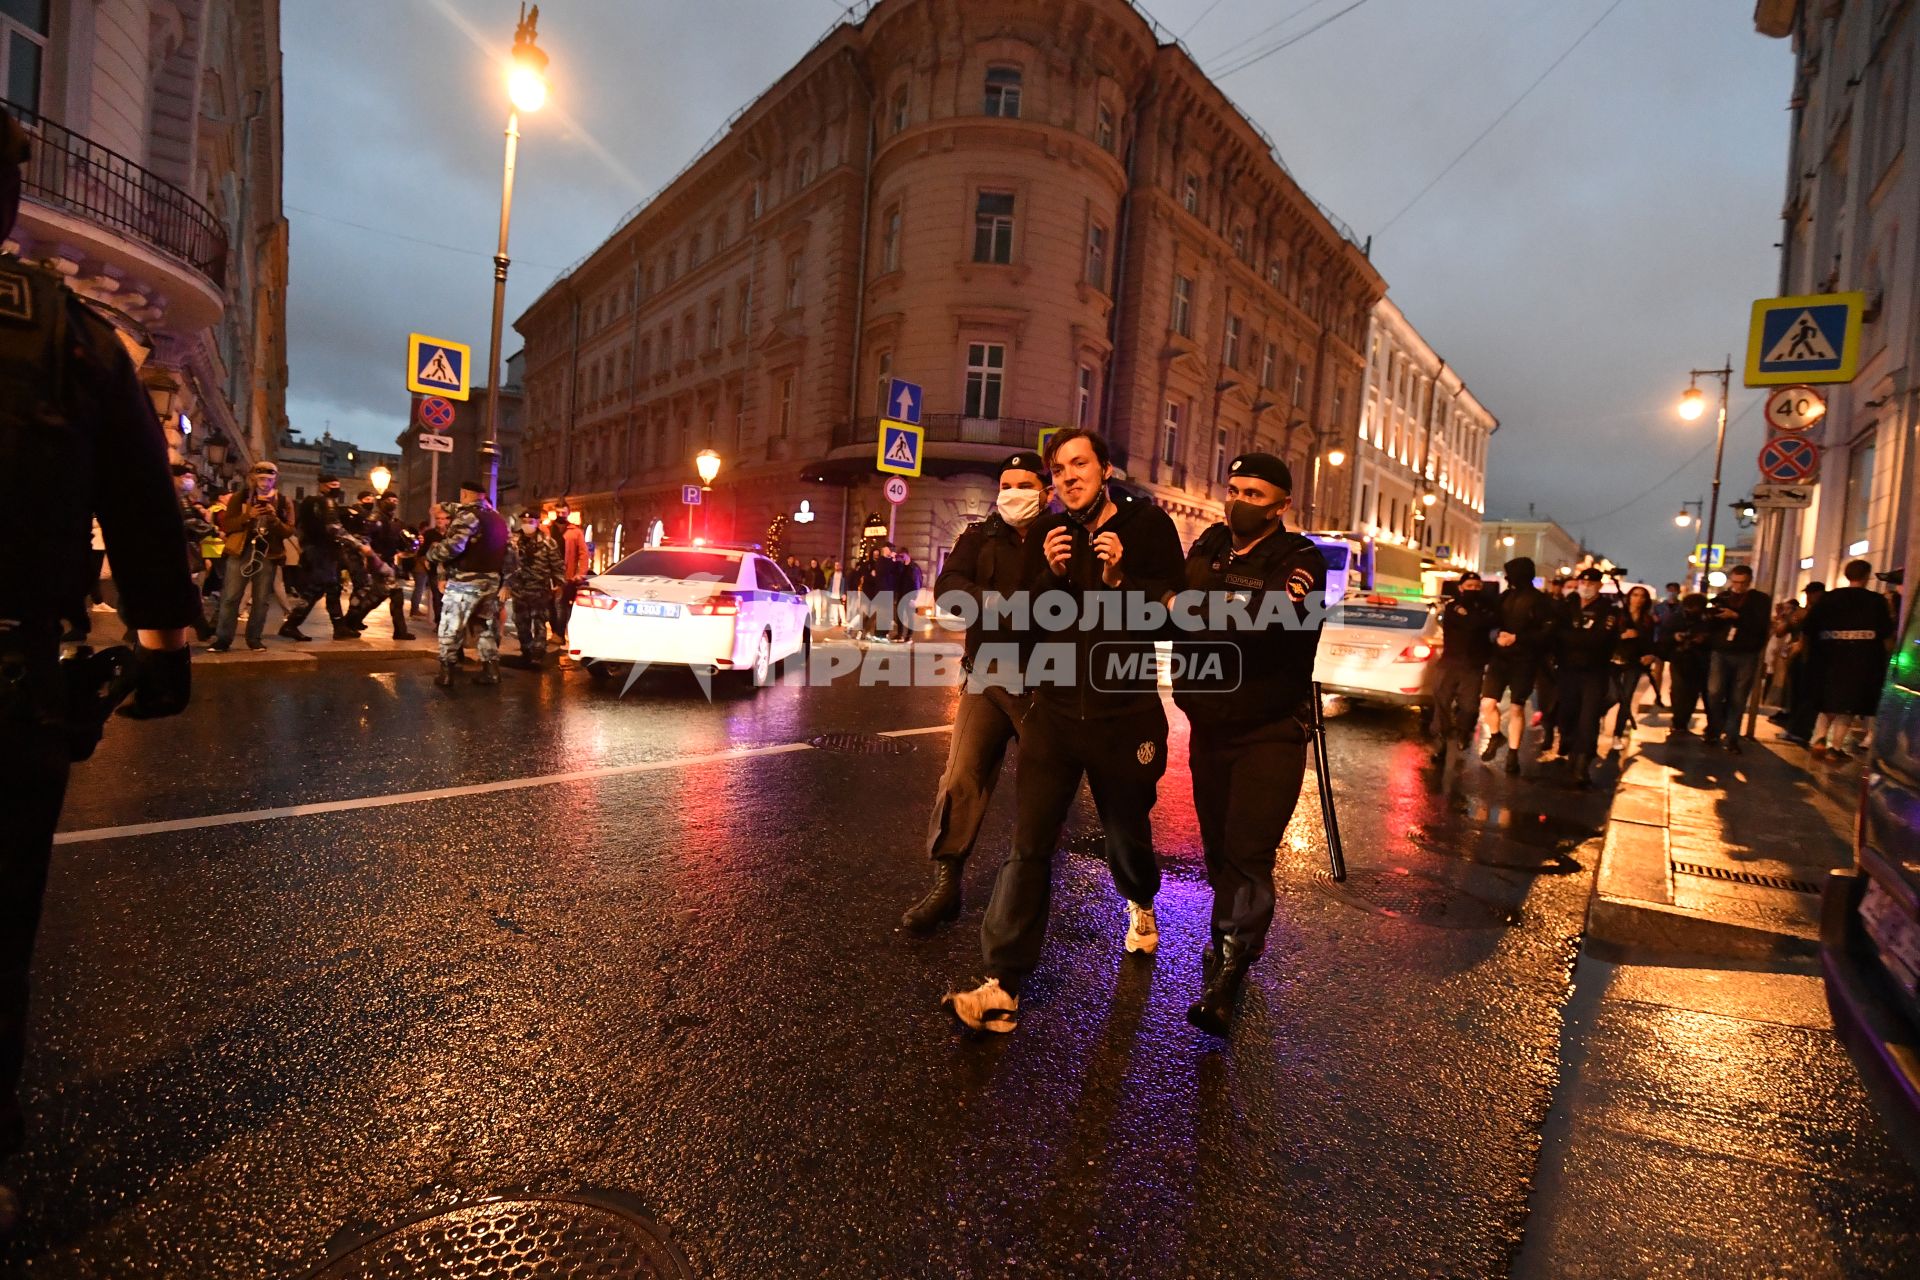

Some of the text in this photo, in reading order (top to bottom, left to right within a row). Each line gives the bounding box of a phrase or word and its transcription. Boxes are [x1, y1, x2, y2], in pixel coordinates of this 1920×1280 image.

[1776, 398, 1809, 417] 40
[688, 488, 698, 502] P
[889, 484, 904, 496] 40
[1228, 575, 1263, 589] ПОЛИЦИЯ
